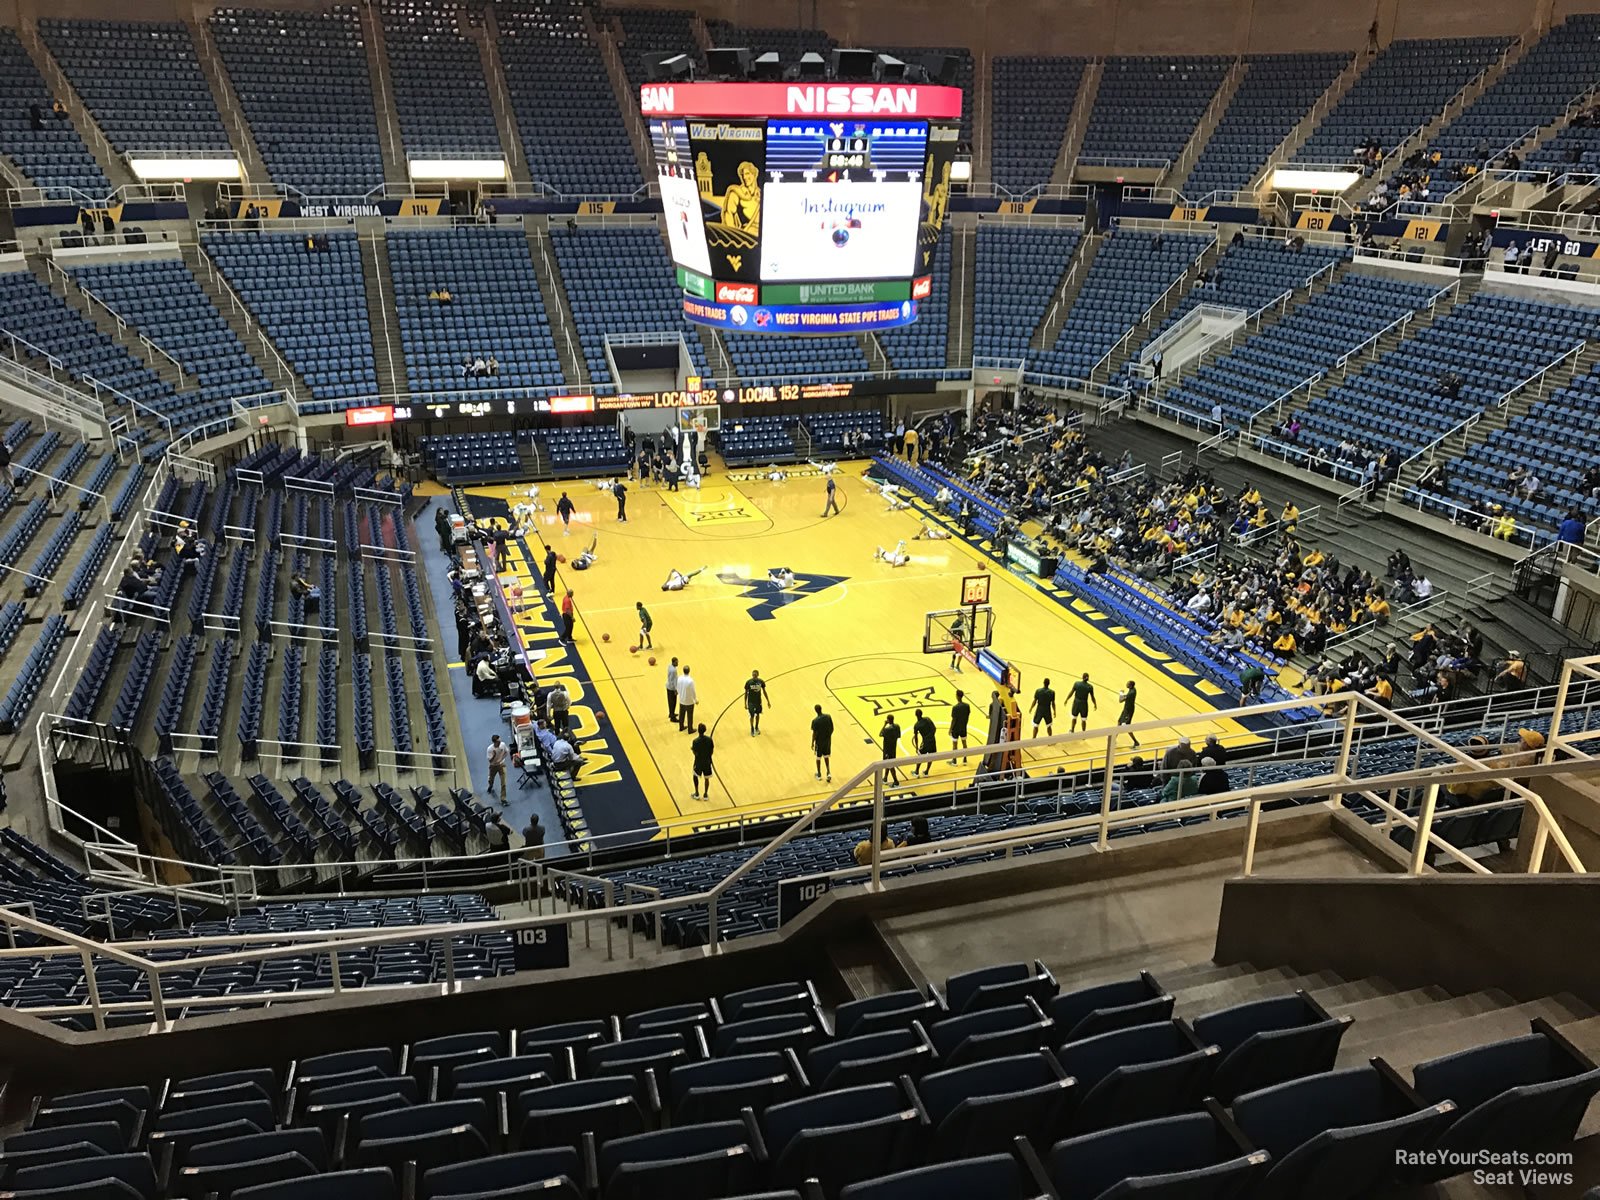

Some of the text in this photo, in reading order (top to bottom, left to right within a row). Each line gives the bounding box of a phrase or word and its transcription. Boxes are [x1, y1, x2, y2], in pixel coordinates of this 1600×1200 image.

[787, 86, 917, 113] NISSAN
[300, 205, 382, 217] WEST VIRGINIA
[412, 204, 428, 216] 114
[589, 203, 604, 214] 115
[801, 197, 885, 221] Instagram
[1010, 203, 1024, 214] 118
[1183, 209, 1196, 221] 119
[1307, 218, 1324, 230] 120
[1415, 227, 1429, 240] 121
[1564, 241, 1580, 256] GO
[810, 283, 875, 296] UNITED BANK
[705, 305, 727, 320] TRADES
[775, 308, 900, 325] WEST VIRGINIA STATE PIPE TRADES
[654, 392, 695, 408] LOCAL
[738, 386, 778, 404] LOCAL
[779, 385, 799, 401] 152
[800, 883, 826, 901] 102
[516, 928, 547, 945] 103
